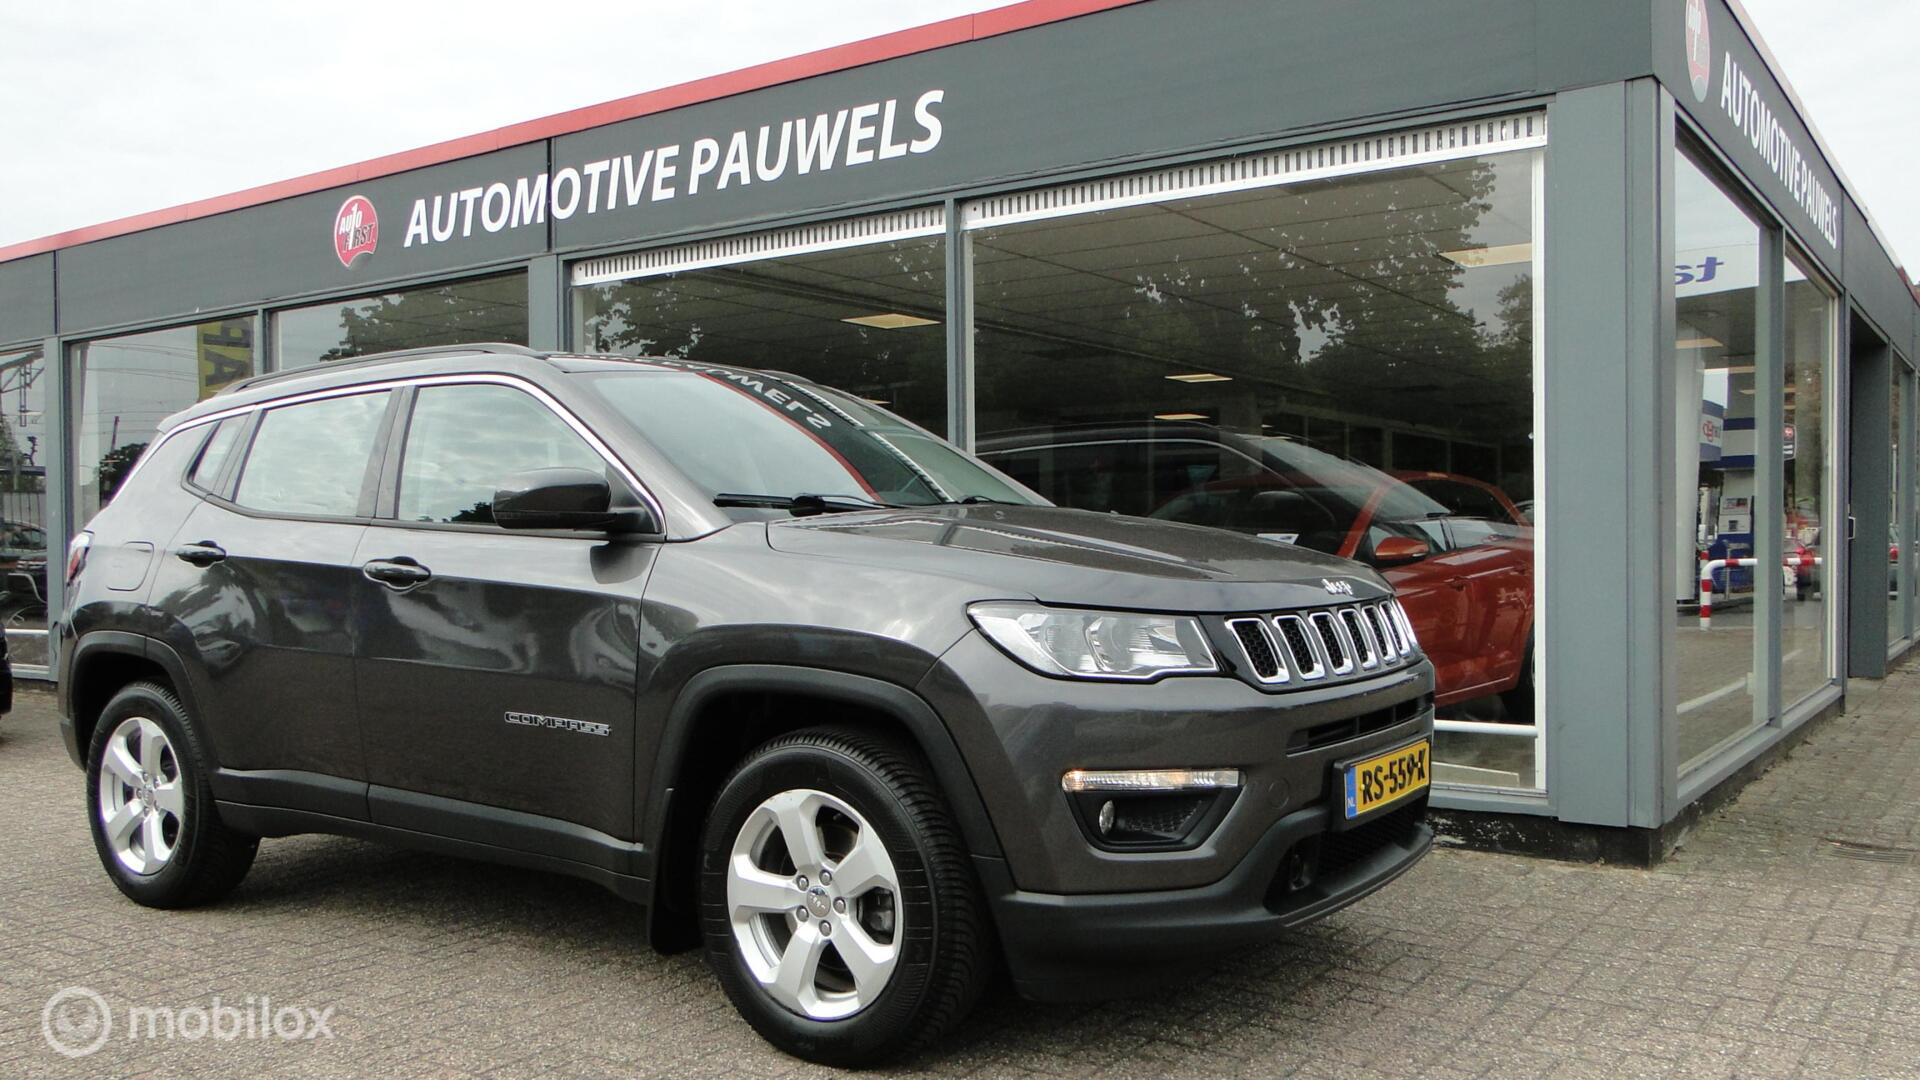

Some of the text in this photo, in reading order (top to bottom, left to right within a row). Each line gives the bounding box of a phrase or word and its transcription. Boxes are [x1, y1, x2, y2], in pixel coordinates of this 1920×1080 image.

[403, 89, 945, 248] AUTOMOTIVE PAUWELS
[1720, 51, 1838, 249] AUTOMOTIVE PAUWELS
[504, 711, 610, 737] COMPASS
[1362, 747, 1427, 806] RS-559-K
